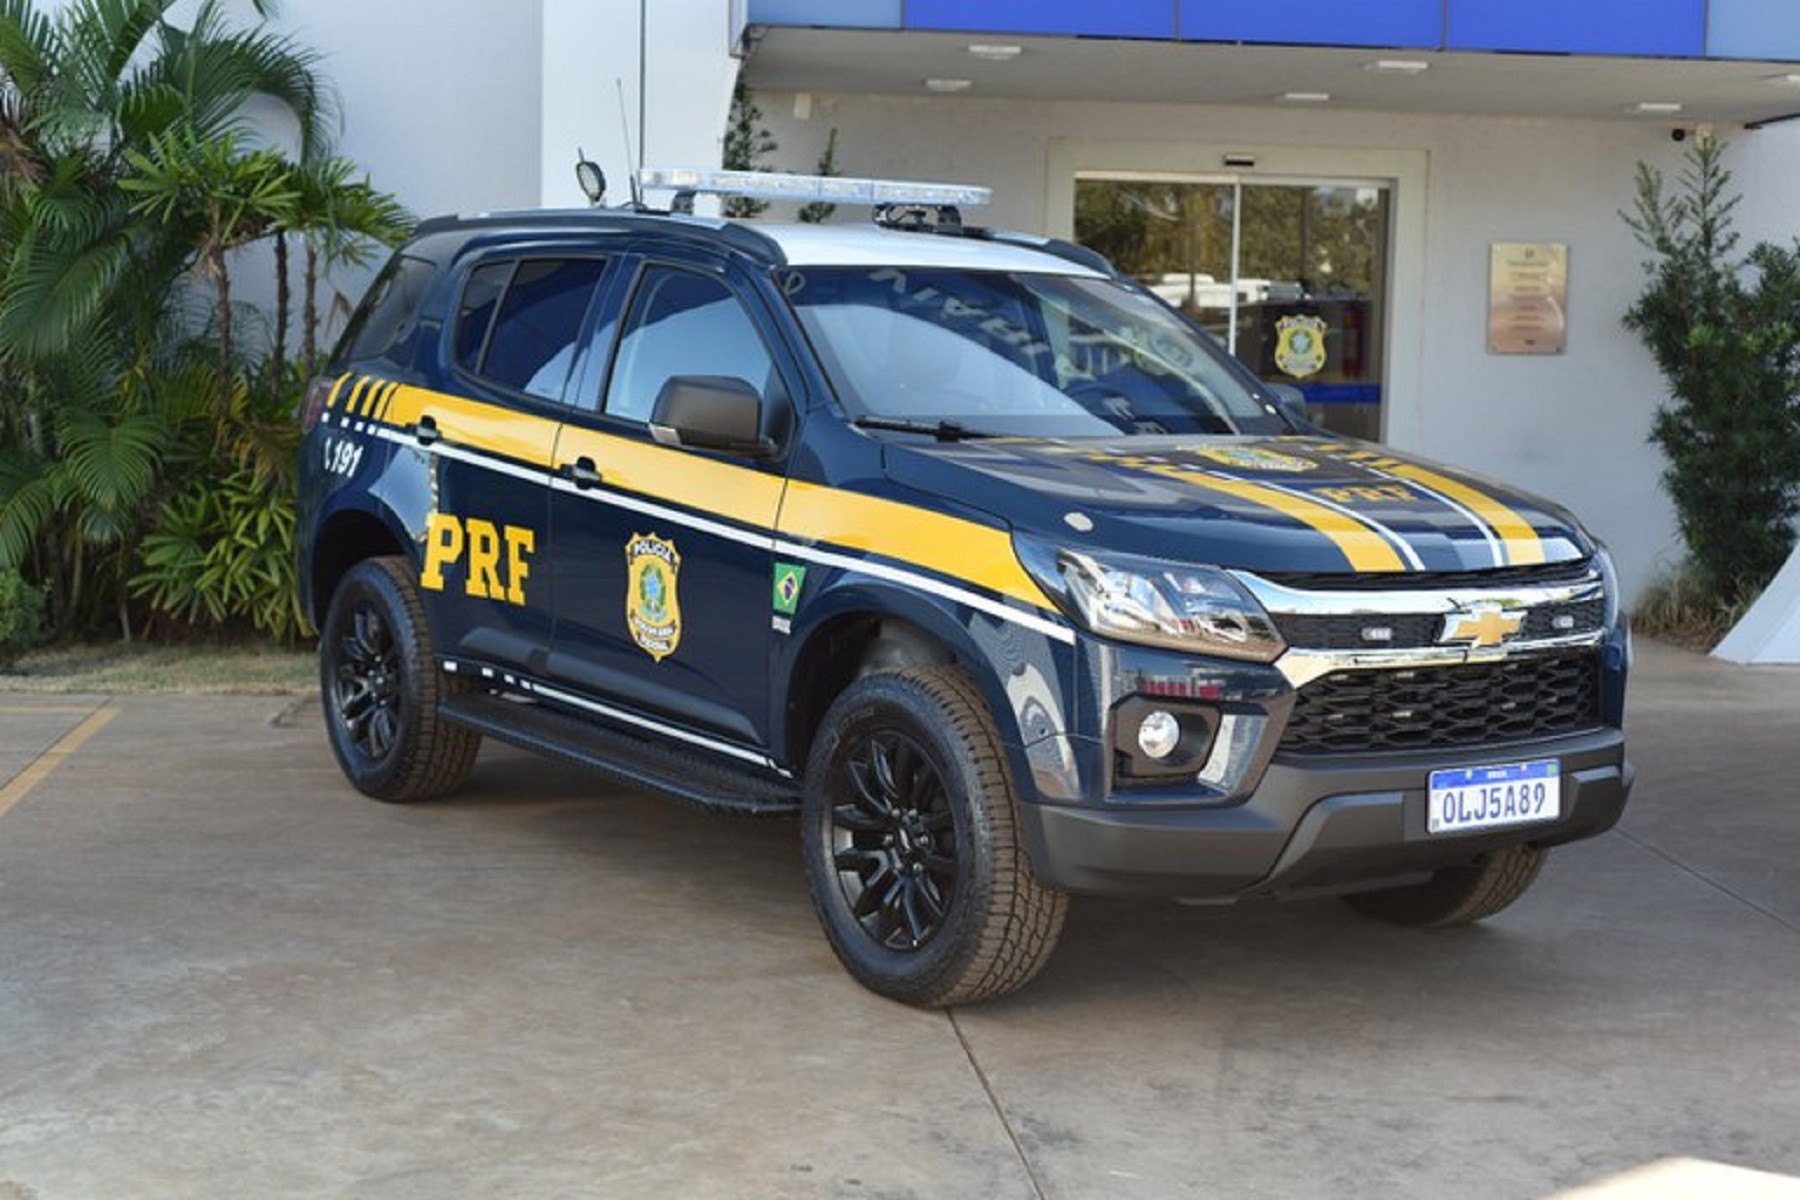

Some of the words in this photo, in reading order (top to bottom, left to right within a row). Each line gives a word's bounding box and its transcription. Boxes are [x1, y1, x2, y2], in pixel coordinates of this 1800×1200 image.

[330, 440, 364, 478] 191
[421, 513, 534, 606] PRF
[1443, 782, 1546, 824] OLJ5A89
